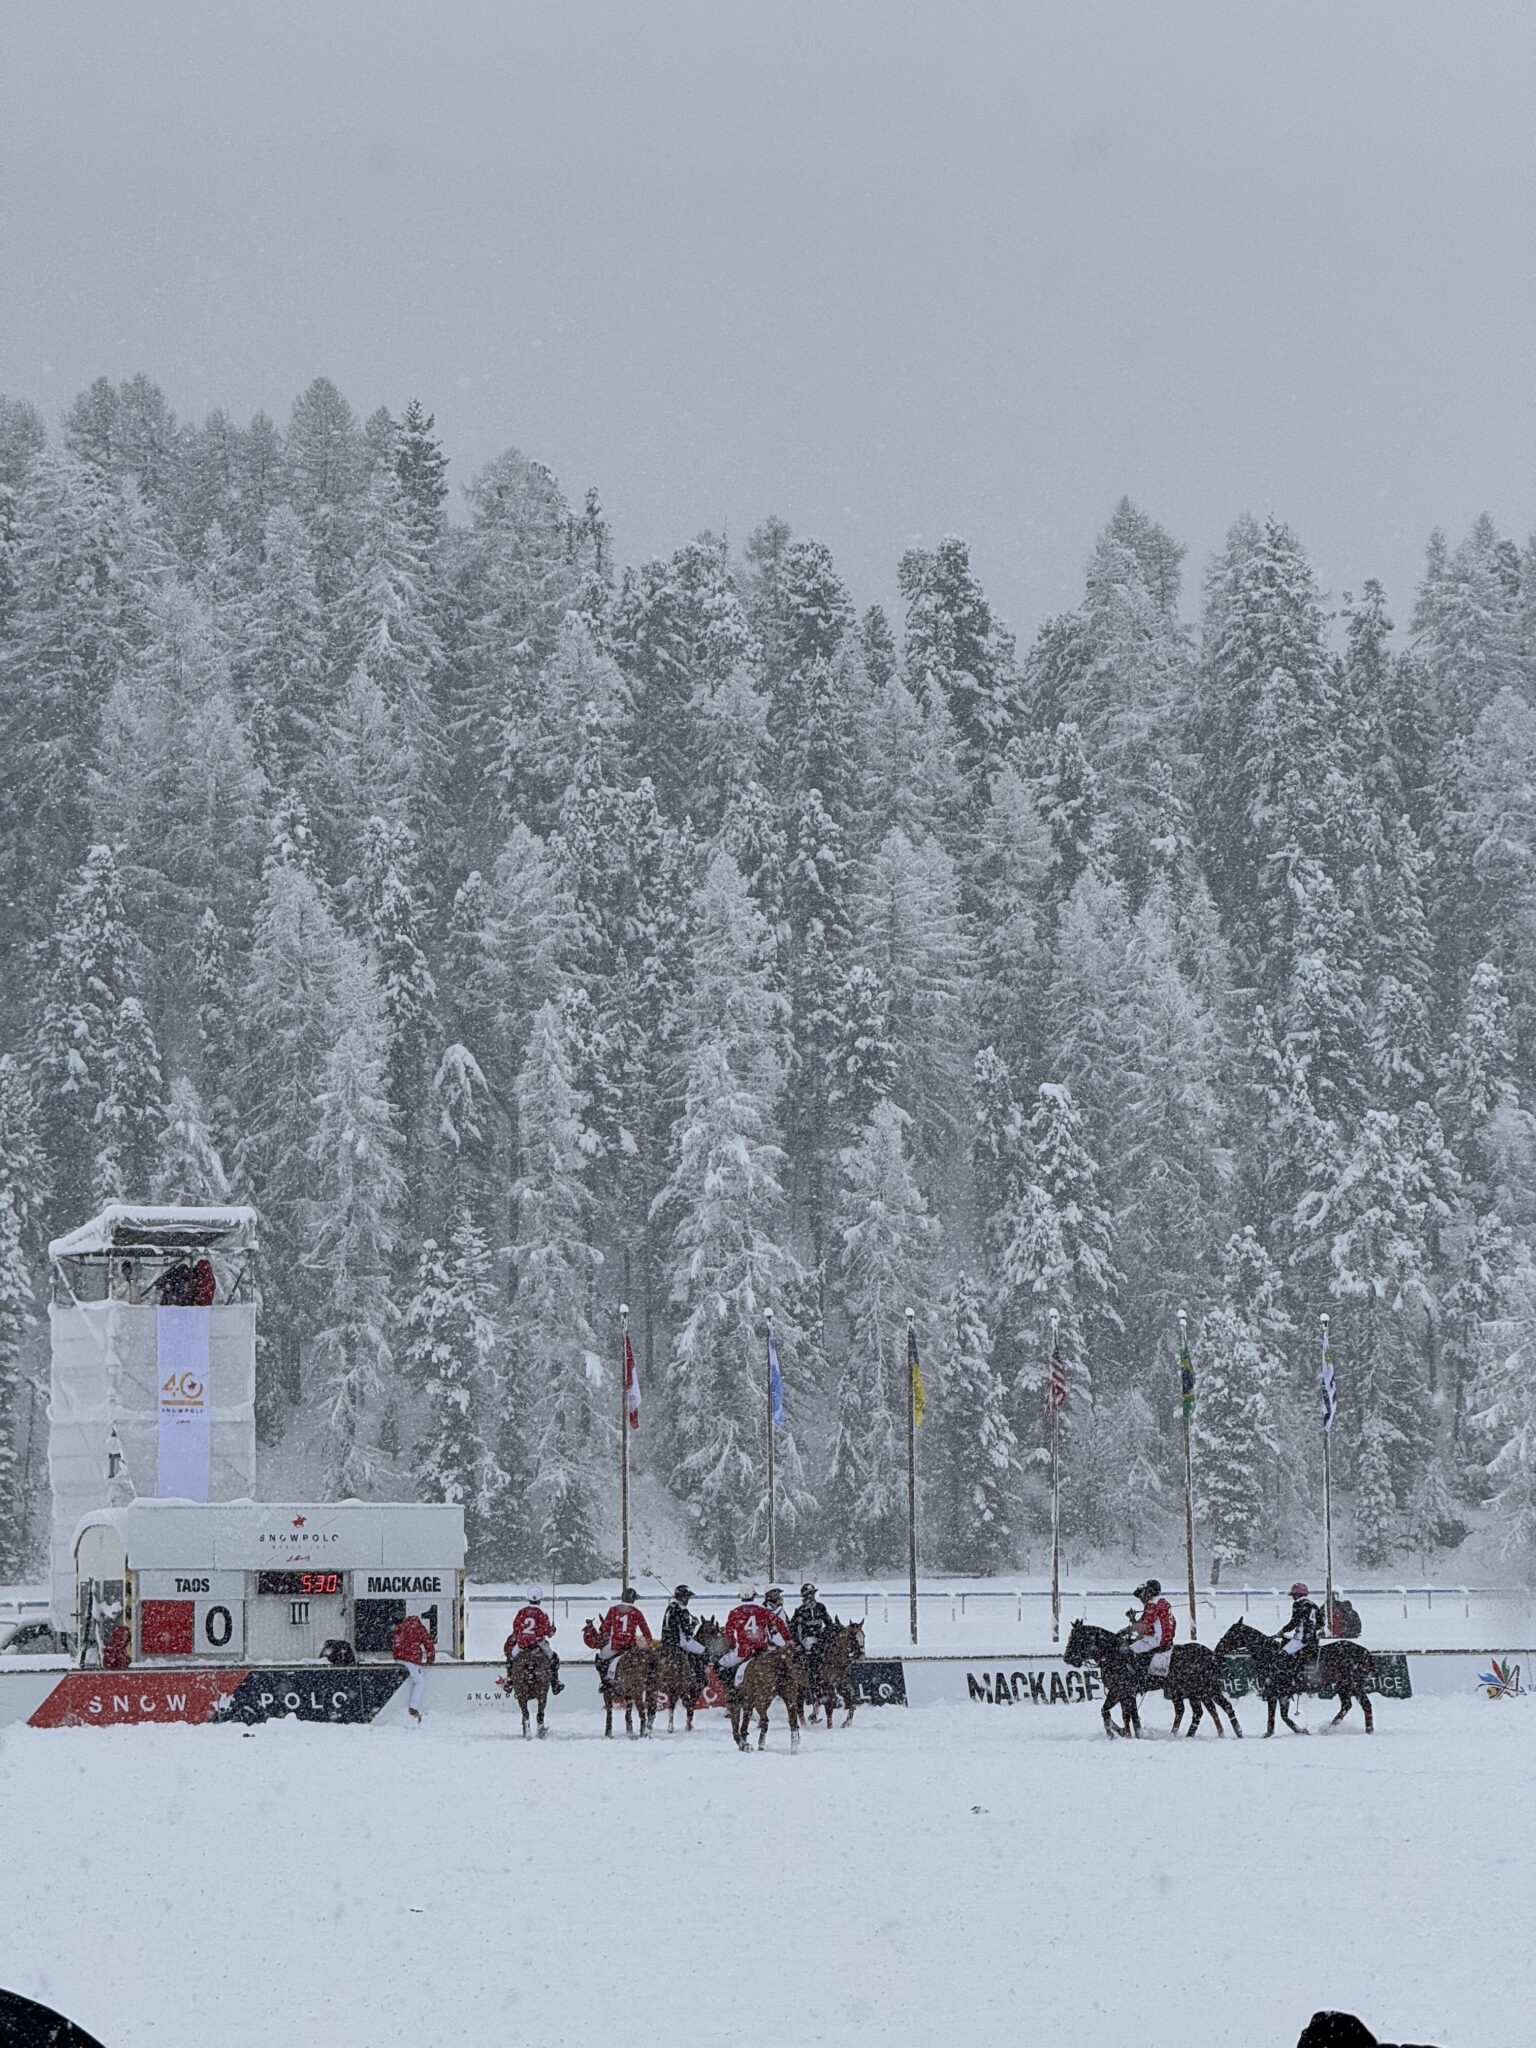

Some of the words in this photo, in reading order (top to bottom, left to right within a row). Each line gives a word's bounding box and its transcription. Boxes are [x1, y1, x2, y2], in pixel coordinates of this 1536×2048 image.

[259, 1534, 339, 1542] SNOWPOLO
[175, 1578, 210, 1593] TAOS
[367, 1576, 442, 1593] MACKAGE
[205, 1605, 233, 1647] 0
[421, 1604, 438, 1645] 1
[522, 1617, 536, 1635] 2
[619, 1614, 629, 1632] 1
[744, 1614, 759, 1635] 4
[966, 1670, 1101, 1705] MACKAGE
[88, 1694, 187, 1714] SNOW
[260, 1691, 348, 1710] POLO
